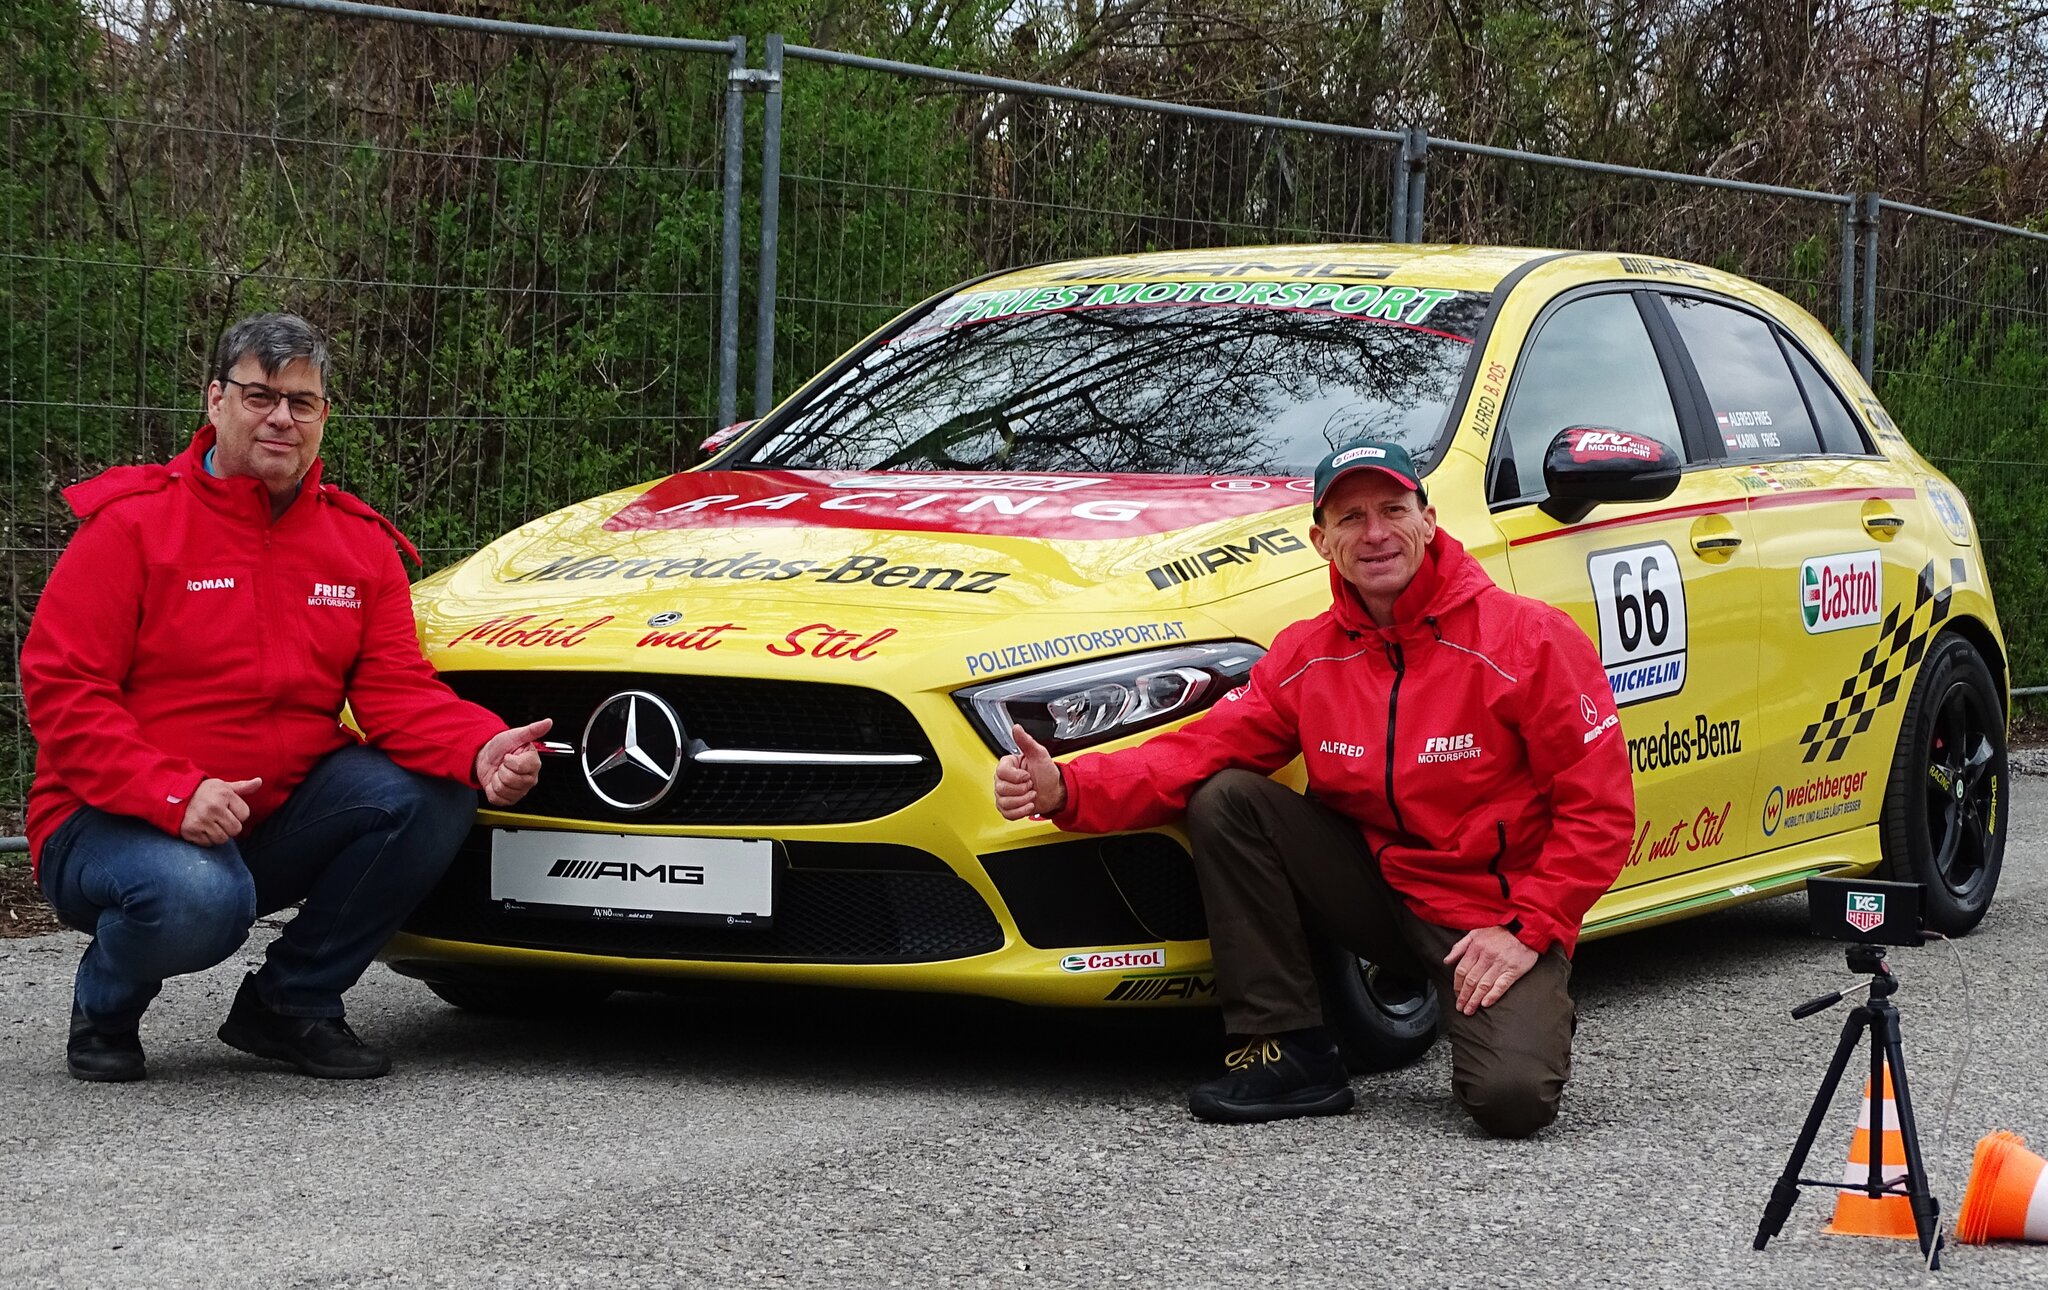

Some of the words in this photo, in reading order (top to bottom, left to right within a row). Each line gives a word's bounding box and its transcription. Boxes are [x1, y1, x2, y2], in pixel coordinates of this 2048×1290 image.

[1138, 262, 1401, 280] AMG
[941, 283, 1083, 328] FRIES
[1083, 281, 1460, 324] MOTORSPORT
[1472, 396, 1496, 441] ALFRED
[1486, 360, 1507, 387] POS
[1728, 411, 1754, 427] ALFRED
[1753, 410, 1773, 426] FRIES
[1588, 444, 1651, 458] MOTORSPORT
[1735, 433, 1760, 449] KARIN
[1761, 432, 1781, 448] FRIES
[655, 492, 1151, 522] RACING
[1190, 527, 1308, 577] AMG
[186, 577, 236, 592] ROMAN
[505, 551, 1011, 594] Mercedes-Benz
[307, 597, 362, 610] MOTORSPORT
[313, 582, 358, 599] FRIES
[1613, 555, 1670, 653] 66
[1821, 560, 1878, 622] Castrol
[448, 615, 614, 649] Mobil
[636, 622, 748, 650] mit
[766, 622, 898, 662] Stil
[965, 621, 1188, 677] POLIZEIMOTORSPORT.AT
[1609, 660, 1681, 694] MICHELIN
[1319, 739, 1365, 758] ALFRED
[1417, 749, 1482, 764] MOTORSPORT
[1424, 733, 1475, 753] FRIES
[1628, 714, 1742, 775] rcedes-Benz
[1785, 770, 1868, 809] weichberger
[1928, 764, 1951, 792] RACING
[1988, 775, 1998, 816] AMG
[1649, 818, 1689, 862] mit
[1686, 801, 1731, 851] Stil
[588, 861, 704, 886] AMG
[1853, 895, 1879, 912] TAG
[1849, 912, 1881, 929] HEUER
[1087, 951, 1161, 969] Castrol
[1146, 975, 1218, 1001] AM
